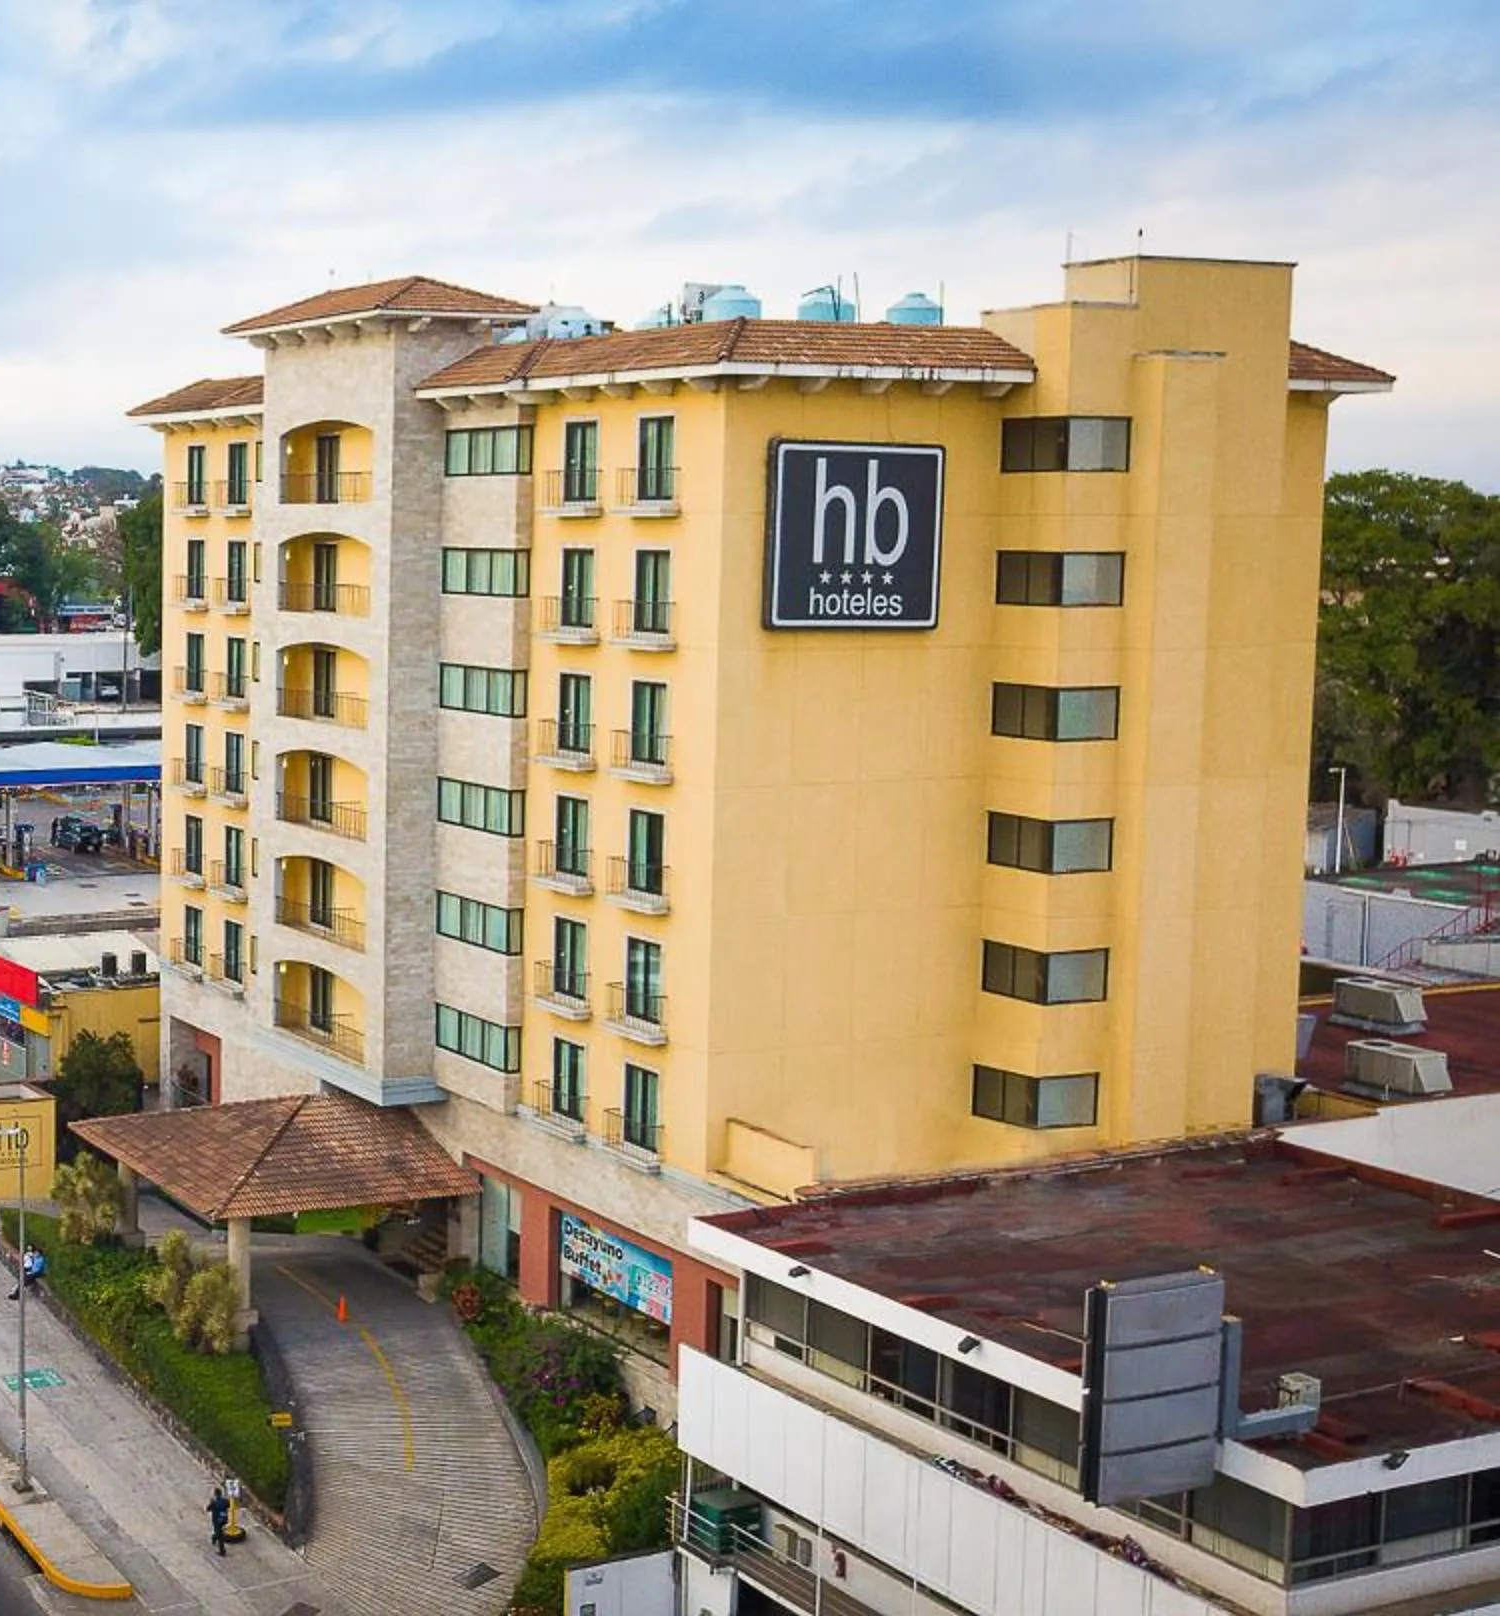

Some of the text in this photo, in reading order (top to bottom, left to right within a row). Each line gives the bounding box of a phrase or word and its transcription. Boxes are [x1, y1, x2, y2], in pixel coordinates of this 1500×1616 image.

[813, 456, 909, 567] hb
[808, 586, 904, 616] hoteles
[564, 1219, 623, 1261] Desayuno
[564, 1243, 602, 1276] Buffet
